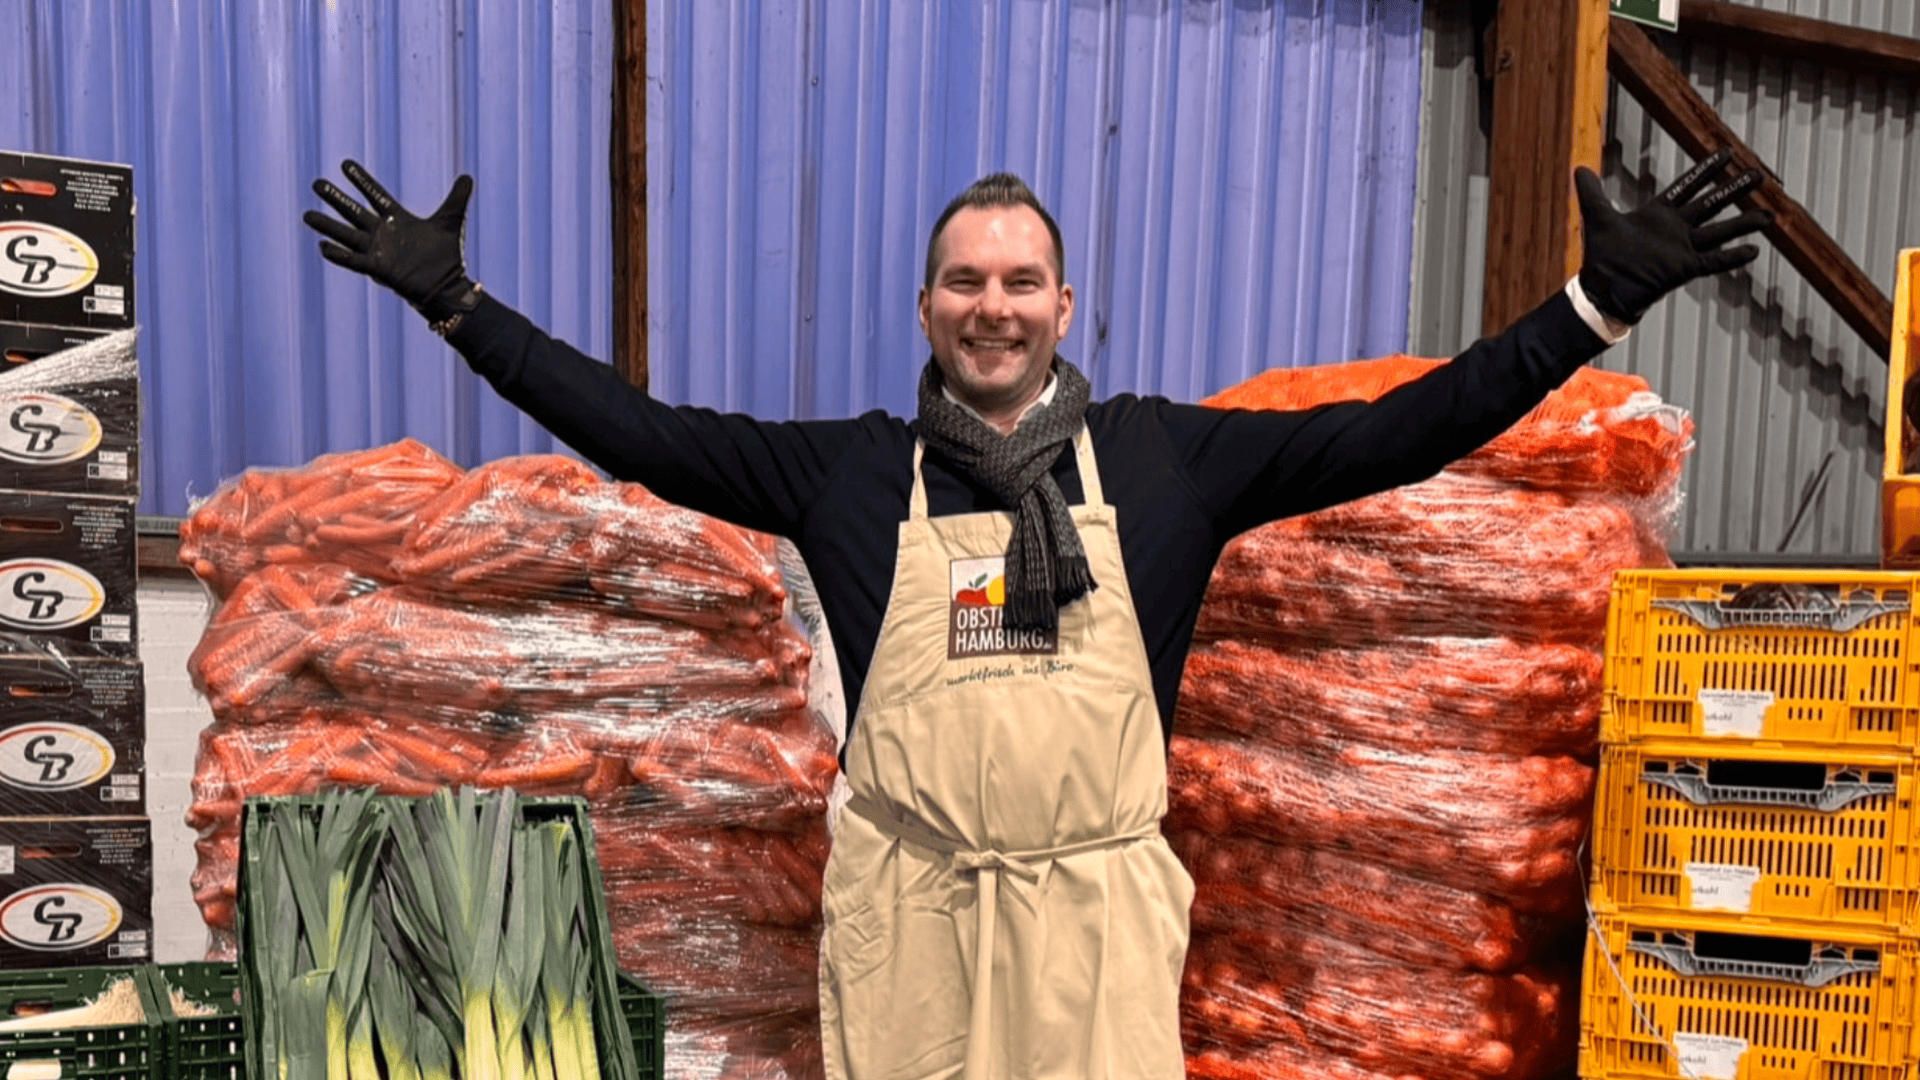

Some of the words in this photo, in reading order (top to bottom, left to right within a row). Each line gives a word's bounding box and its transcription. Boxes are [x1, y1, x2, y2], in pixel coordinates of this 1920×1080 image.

[324, 184, 362, 214] STRAUSS
[1703, 174, 1752, 208] STRAUSS
[946, 663, 1015, 686] marktfrisch
[1045, 660, 1074, 674] Büro
